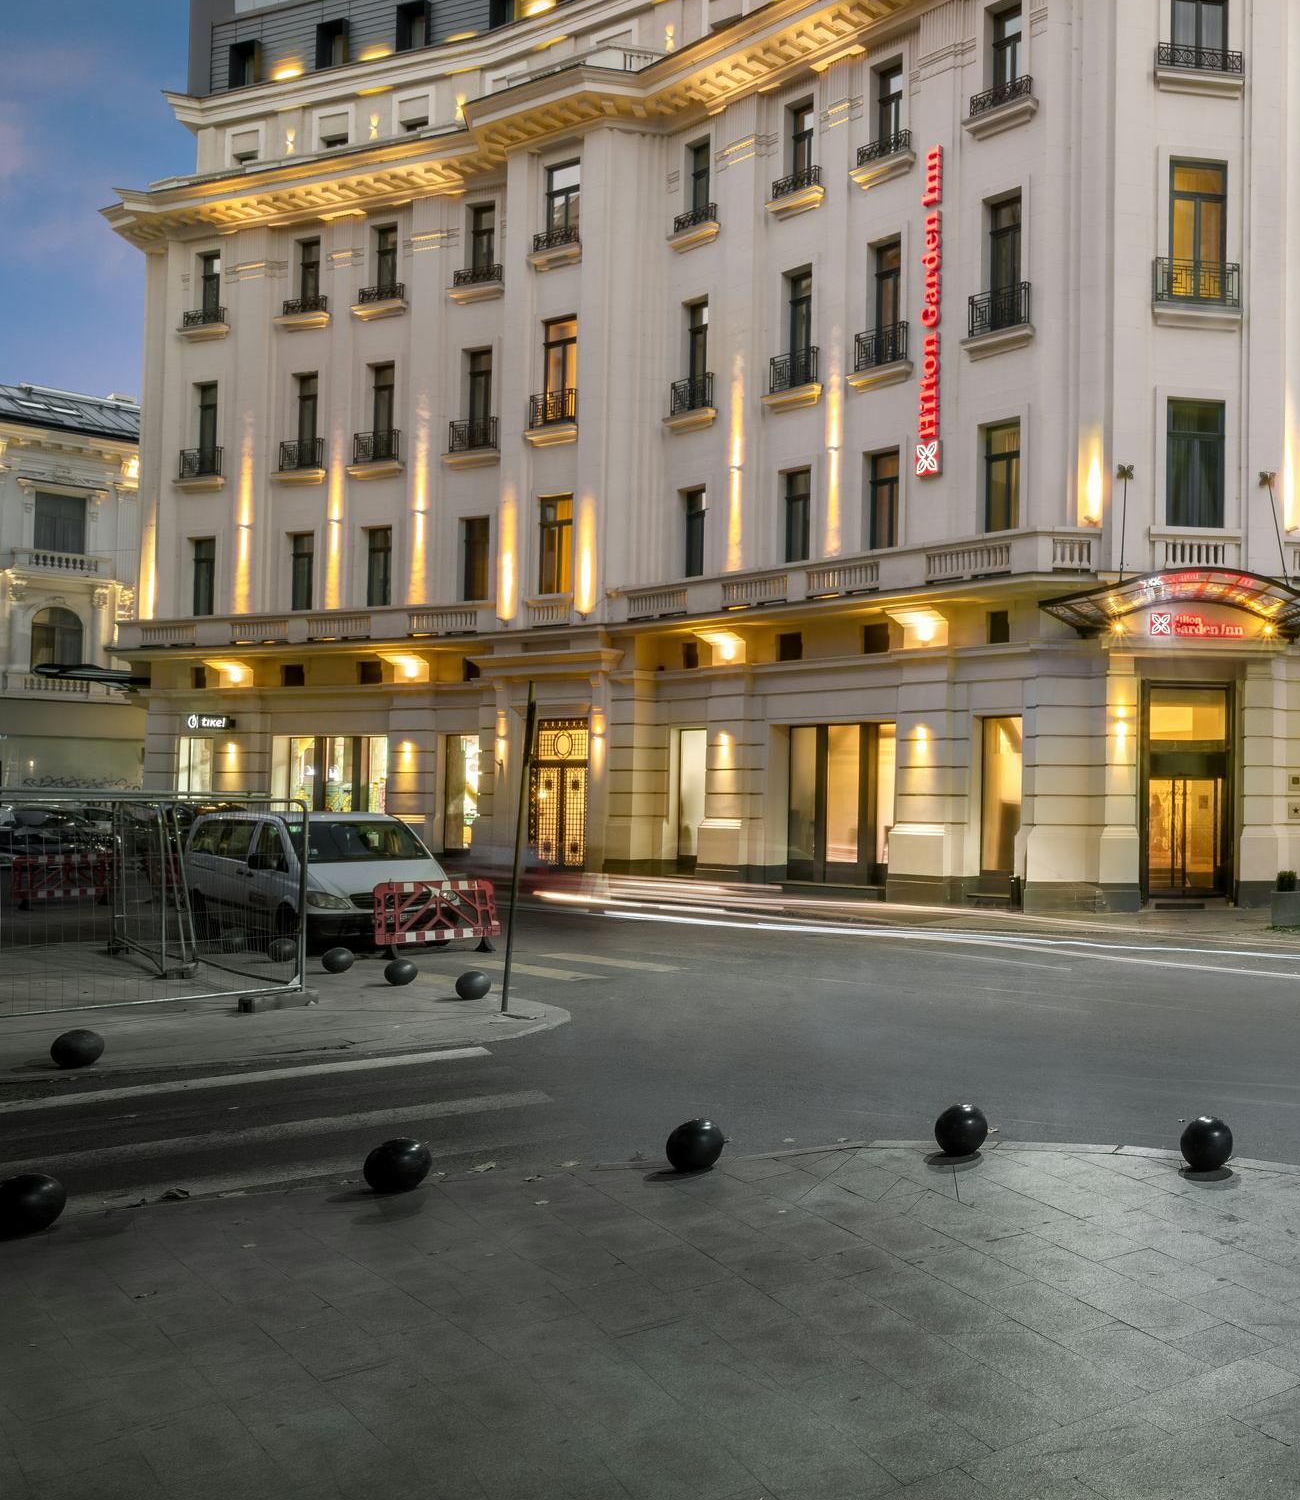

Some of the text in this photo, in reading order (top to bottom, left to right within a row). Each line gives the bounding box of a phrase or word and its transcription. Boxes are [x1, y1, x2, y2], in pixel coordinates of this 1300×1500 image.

[919, 144, 943, 439] Hilton Garden Inn
[1174, 614, 1202, 625] ilton
[1220, 623, 1244, 636] Inn
